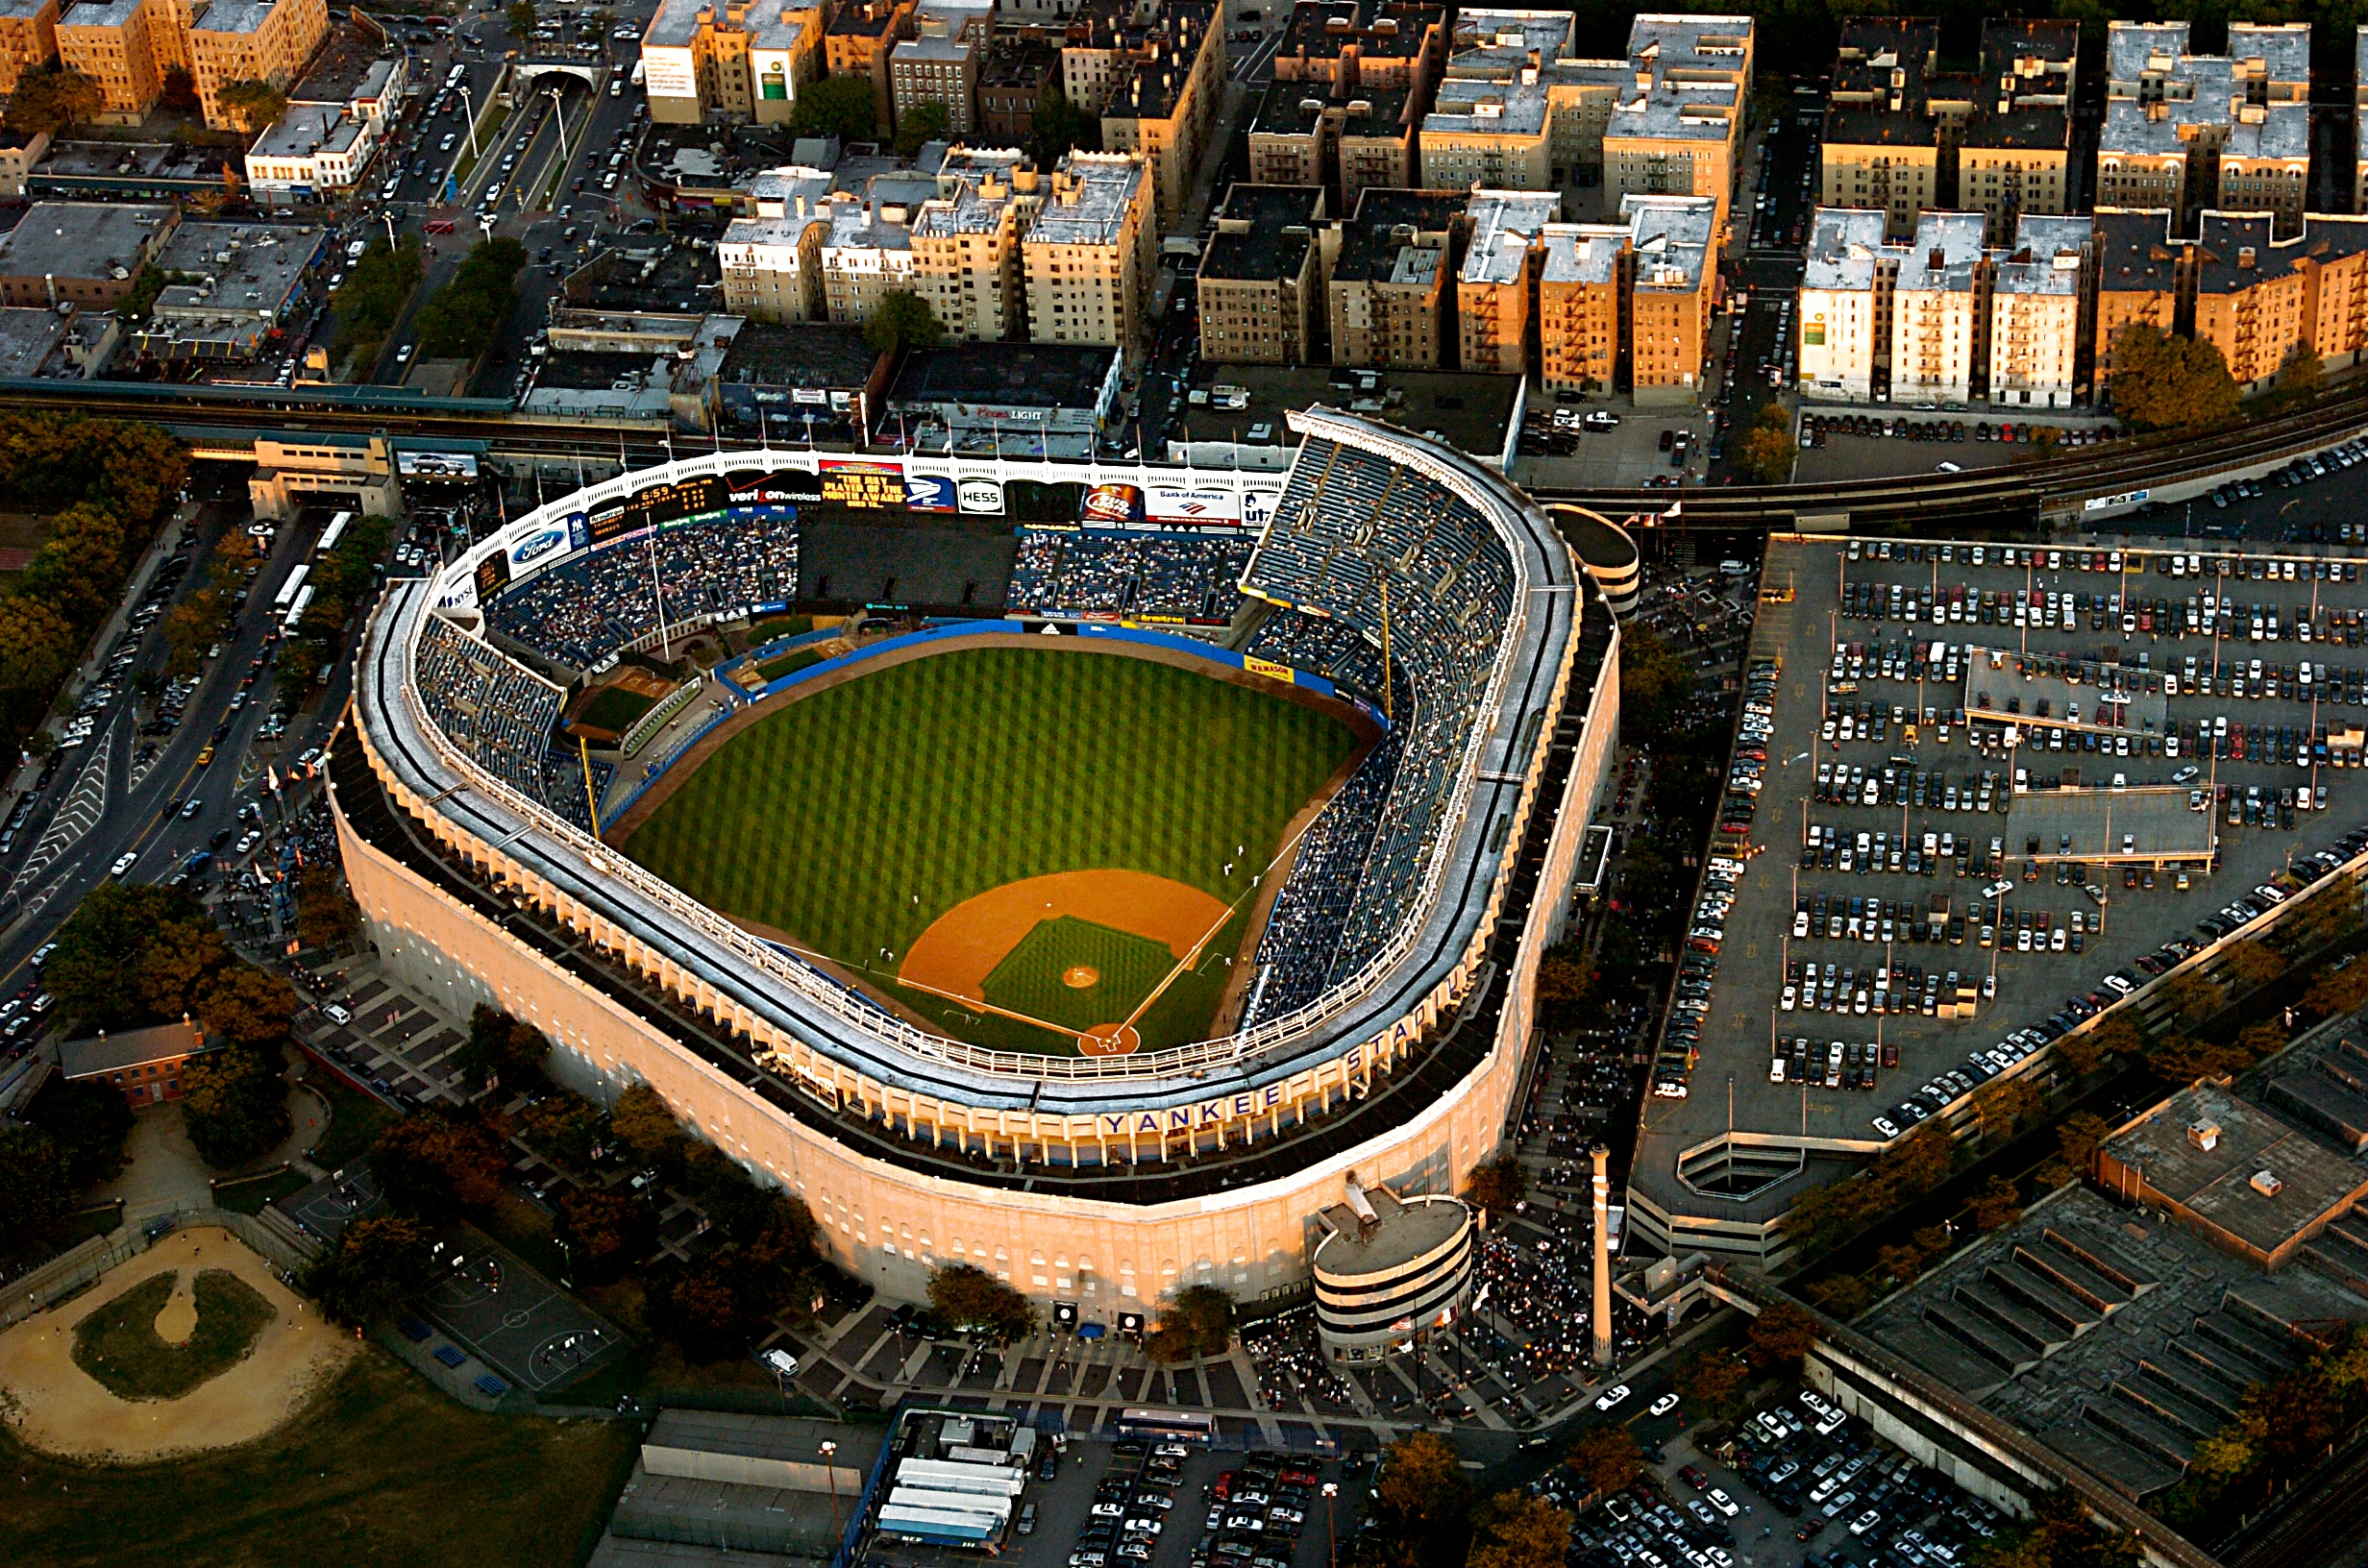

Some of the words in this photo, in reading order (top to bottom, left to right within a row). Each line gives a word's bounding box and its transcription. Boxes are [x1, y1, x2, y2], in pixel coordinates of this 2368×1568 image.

[1011, 410, 1042, 421] LIGHT
[864, 476, 888, 485] JULY
[641, 486, 669, 501] 6:59
[728, 488, 784, 503] verizon
[824, 482, 864, 493] PLAYER
[866, 484, 880, 493] OF
[882, 485, 903, 495] THE
[822, 491, 859, 501] MONTH
[963, 491, 999, 503] HESS
[1190, 492, 1224, 501] America
[522, 535, 555, 560] Ford
[454, 584, 474, 605] NYSE
[1347, 951, 1468, 1072] STADIU
[1104, 1084, 1280, 1134] YANKEE
